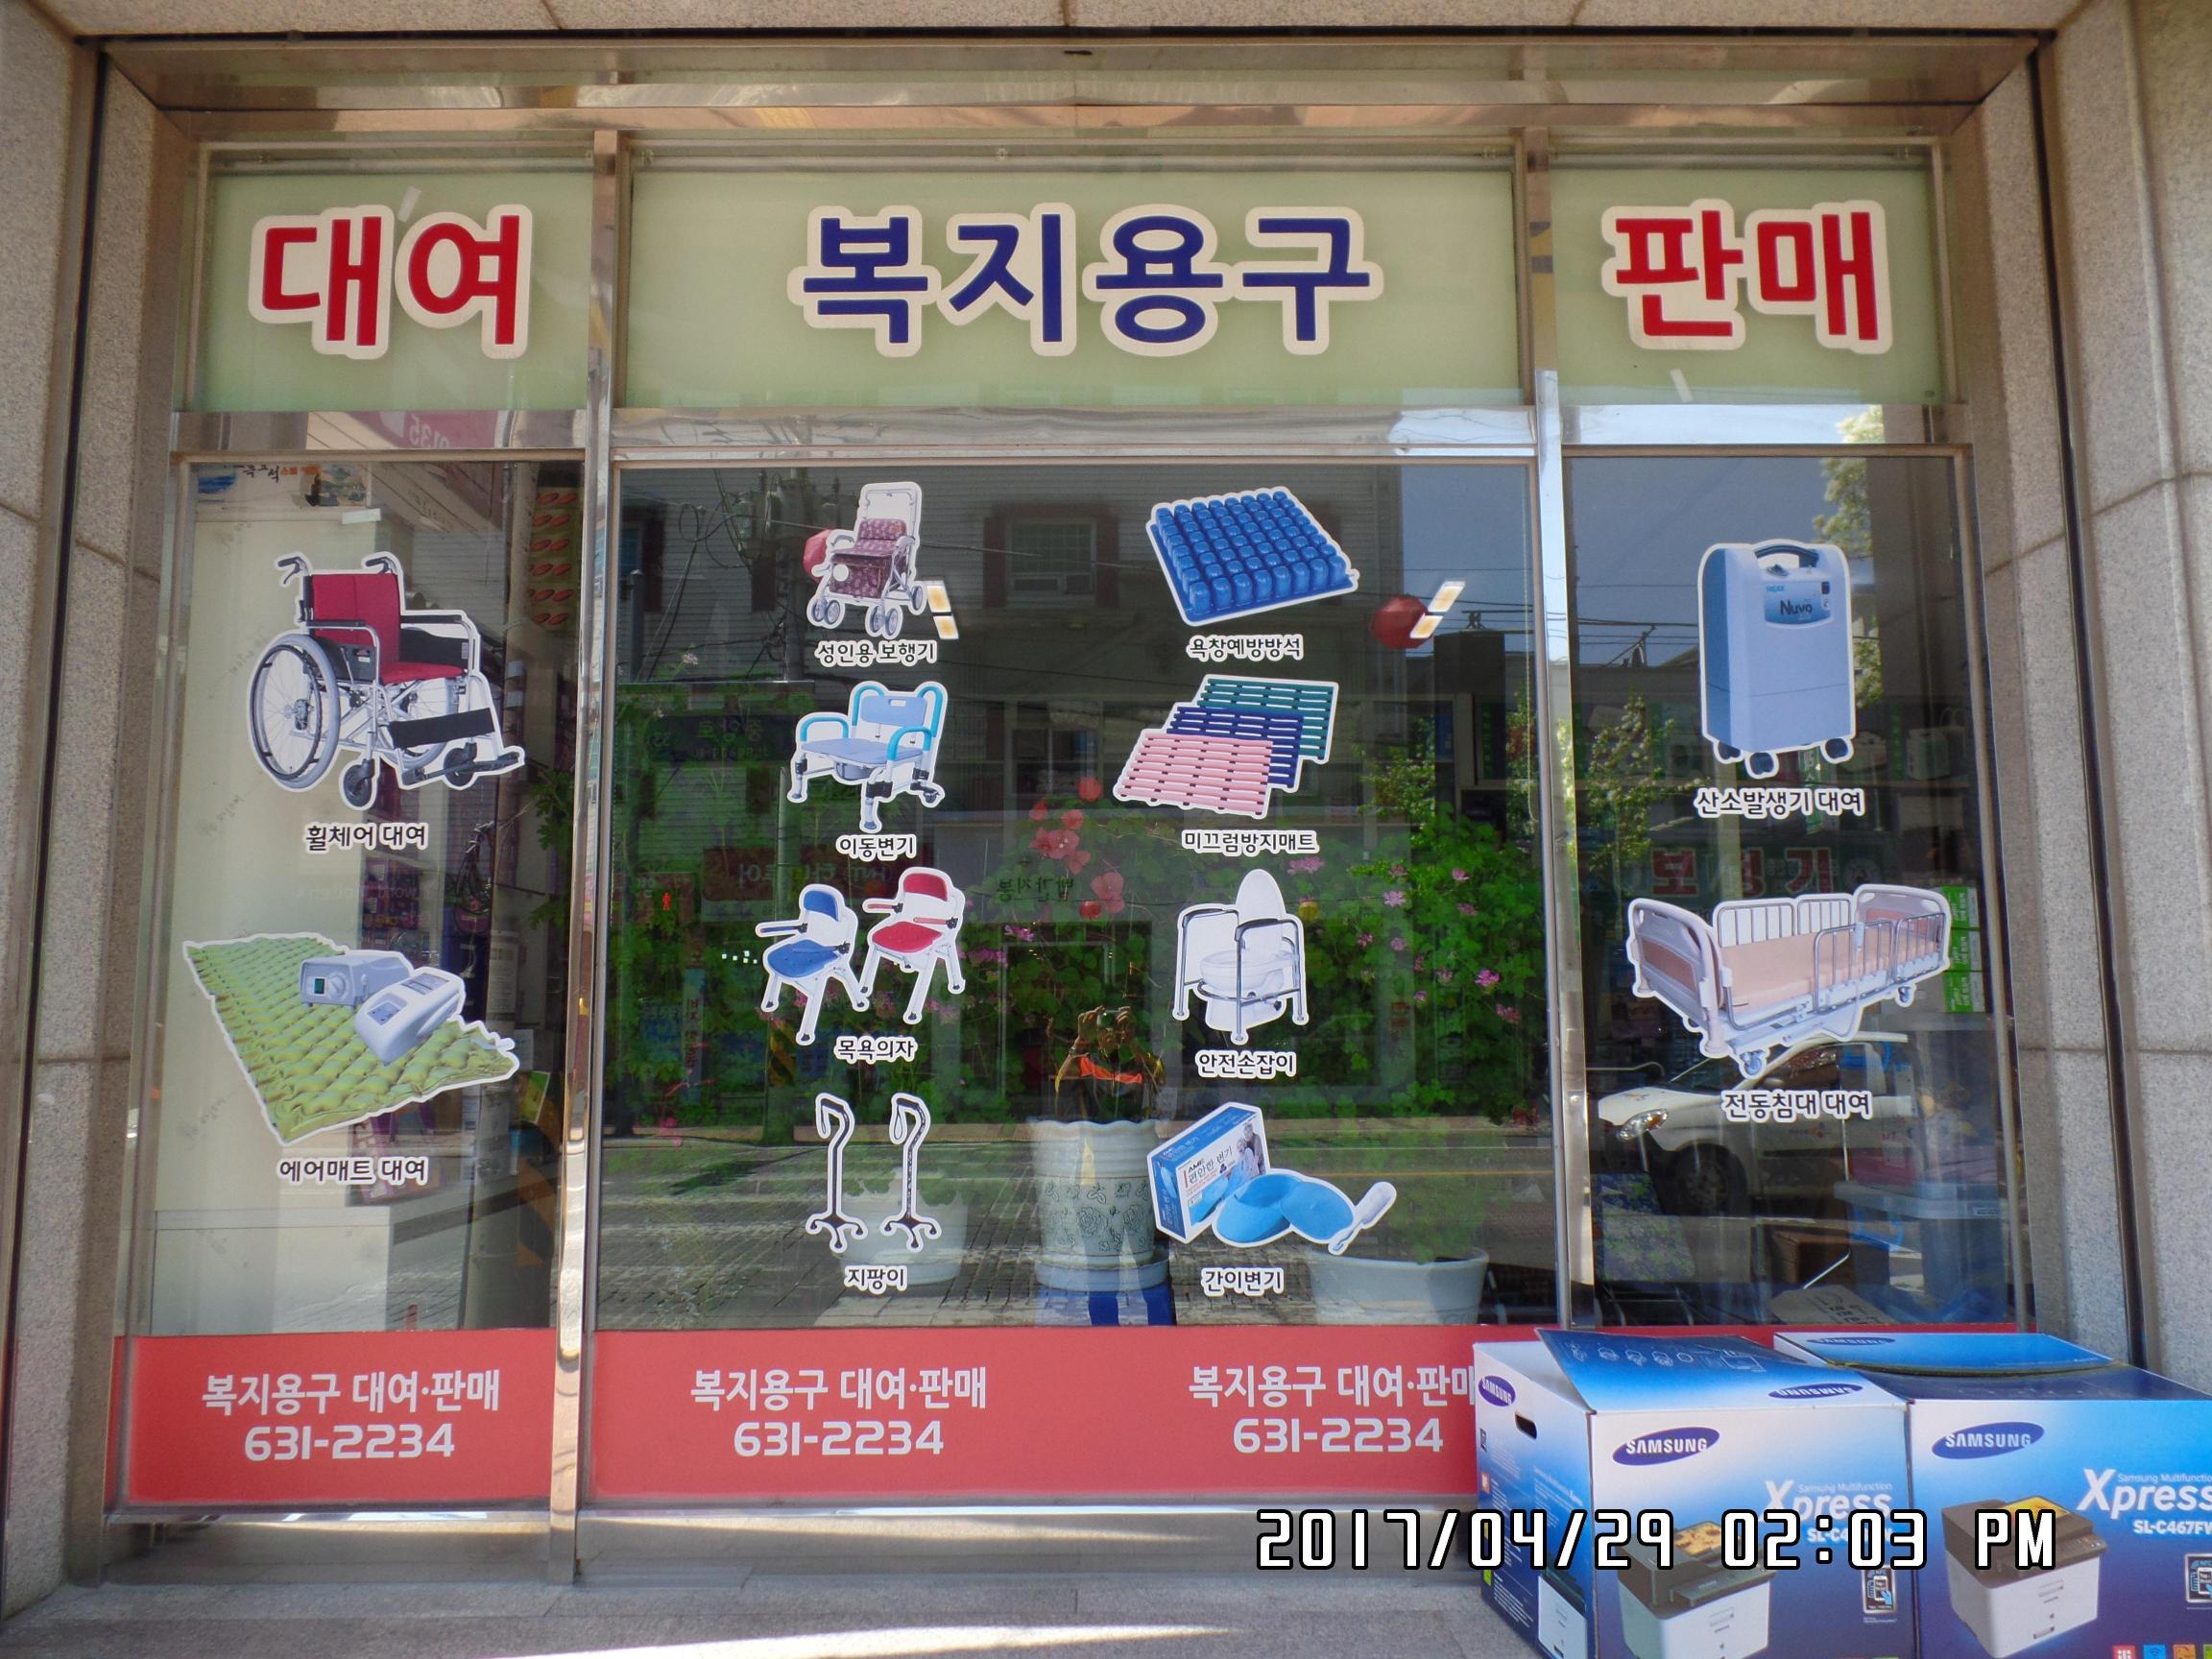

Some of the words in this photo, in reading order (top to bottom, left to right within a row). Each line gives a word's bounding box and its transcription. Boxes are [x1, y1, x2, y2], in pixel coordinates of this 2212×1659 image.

[261, 214, 520, 347] 대여
[803, 213, 1371, 345] 복지용구
[1615, 209, 1879, 341] 판매
[1780, 599, 1814, 615] Nuvo
[817, 640, 873, 664] 성인용
[879, 640, 936, 663] 보행기
[1189, 636, 1303, 659] 욕창예방방석
[1696, 788, 1810, 816] 산소발생기
[1817, 788, 1863, 814] 대여
[306, 824, 375, 851] 휠체어
[383, 823, 426, 848] 대여
[838, 834, 916, 857] 이동변기
[1184, 831, 1319, 855] 미끄럼방지매트
[837, 1039, 916, 1061] 목욕의자
[1197, 1052, 1295, 1076] 안전손잡이
[1723, 1093, 1817, 1121] 전동침대
[1825, 1093, 1871, 1118] 대여
[278, 1158, 373, 1183] 에어매트
[381, 1157, 426, 1184] 대여
[847, 1267, 906, 1291] 지팡이
[1204, 1270, 1284, 1293] 간이변기
[202, 1373, 342, 1417] 복지용구
[352, 1368, 501, 1412] 대여·판매
[690, 1368, 829, 1412] 복지용구
[840, 1366, 988, 1410] 대여·판매
[1188, 1365, 1327, 1408] 복지용구
[1481, 1374, 1513, 1407] SAMSUNG
[244, 1422, 455, 1462] 631-2234
[733, 1420, 945, 1457] 631-2234
[1233, 1417, 1444, 1455] 631-2234
[1624, 1436, 1708, 1455] SAMSUNG
[1943, 1431, 2032, 1450] SAMSUNG
[1797, 1483, 1837, 1494] Samsung
[1838, 1481, 1893, 1491] Multifunction
[2117, 1474, 2158, 1483] Samsung
